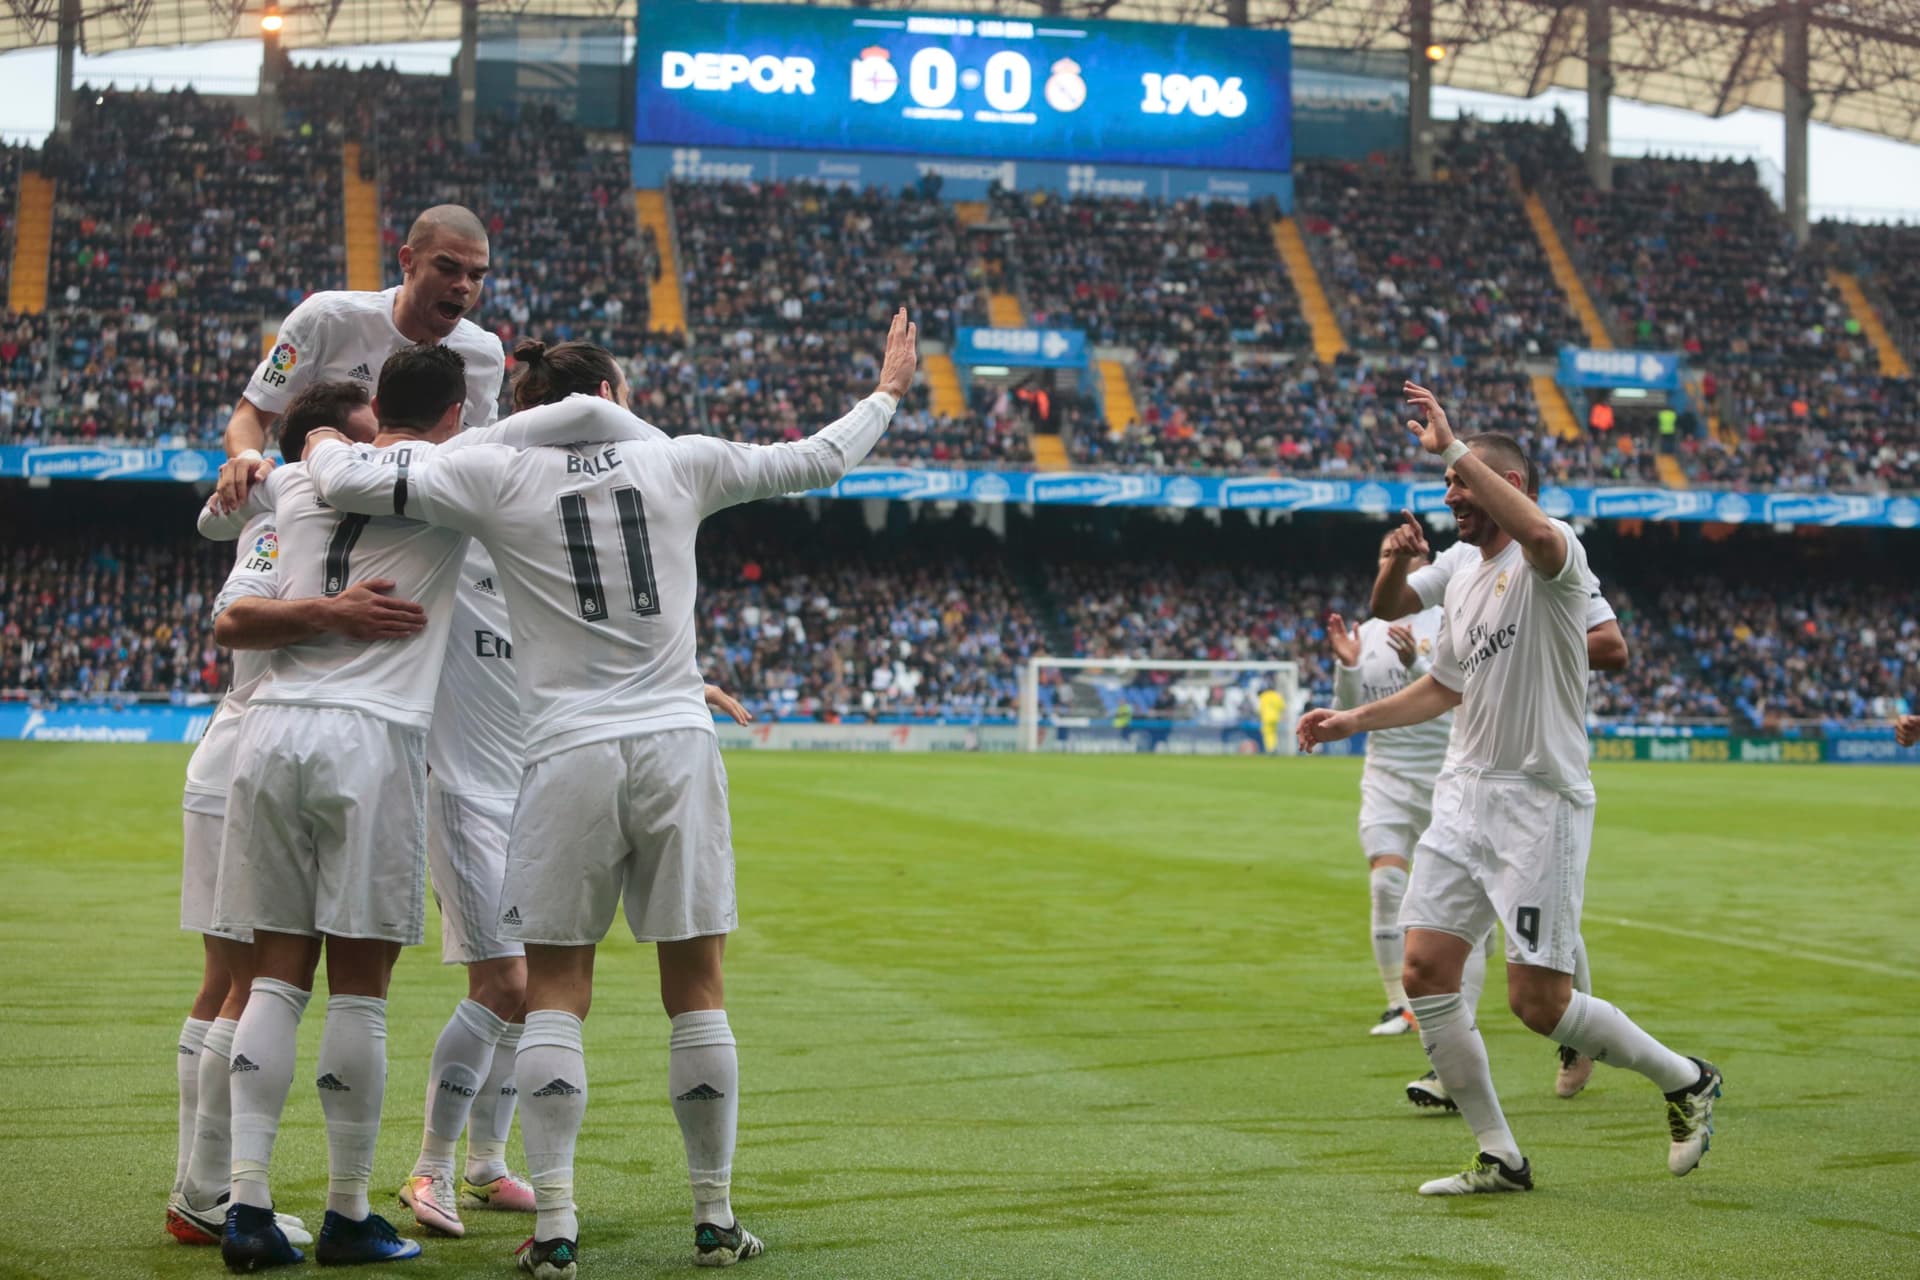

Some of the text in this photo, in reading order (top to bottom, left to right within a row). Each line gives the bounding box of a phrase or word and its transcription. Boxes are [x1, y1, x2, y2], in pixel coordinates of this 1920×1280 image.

[661, 51, 816, 95] DEPOR
[909, 47, 1032, 111] 0 0
[1140, 72, 1248, 118] 1906
[262, 367, 287, 388] LFP
[567, 447, 623, 477] BALE
[245, 557, 273, 573] LFP
[312, 496, 372, 597] 7
[556, 483, 661, 622] 11
[1650, 740, 1729, 760] bet365
[1741, 741, 1819, 761] bet365
[1517, 906, 1541, 953] 9
